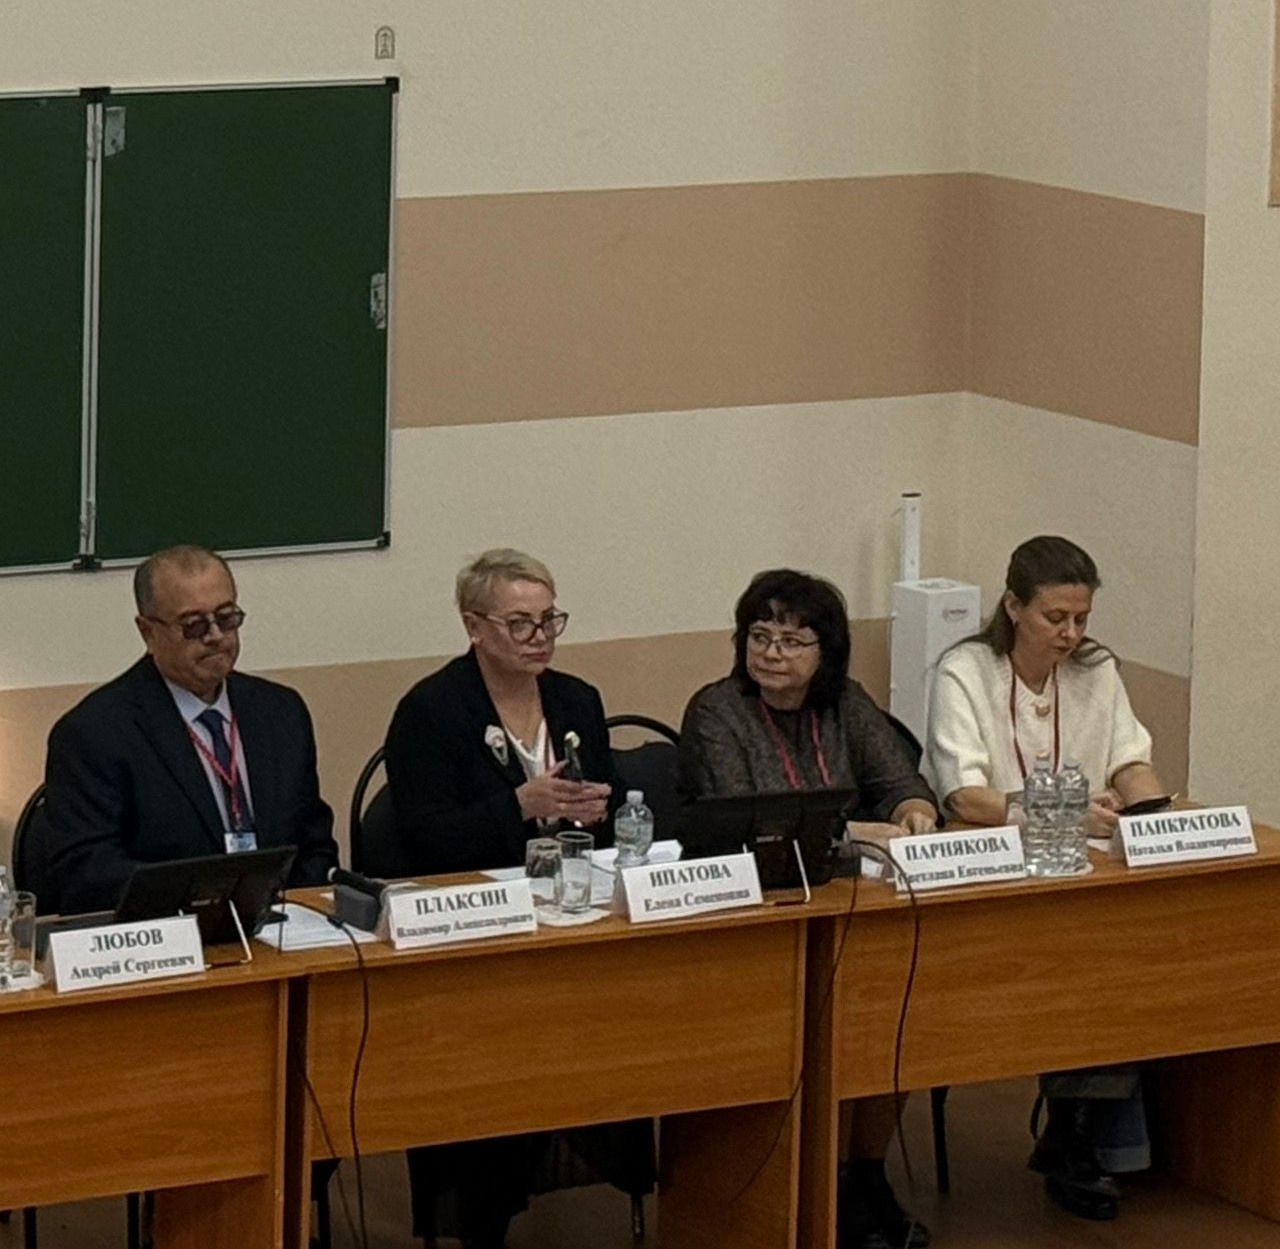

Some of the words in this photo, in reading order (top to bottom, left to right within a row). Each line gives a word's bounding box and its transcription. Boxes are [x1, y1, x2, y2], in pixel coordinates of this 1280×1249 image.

[1130, 812, 1242, 838] ПАНКРАТОВА
[904, 836, 1011, 861] ПАРНЯКОВА
[649, 863, 732, 888] ИПАТОВА
[415, 888, 509, 915] ПЛАКСИН
[644, 897, 682, 912] Елена
[89, 928, 164, 952] ЛЮБОВ
[70, 960, 121, 980] Андрей
